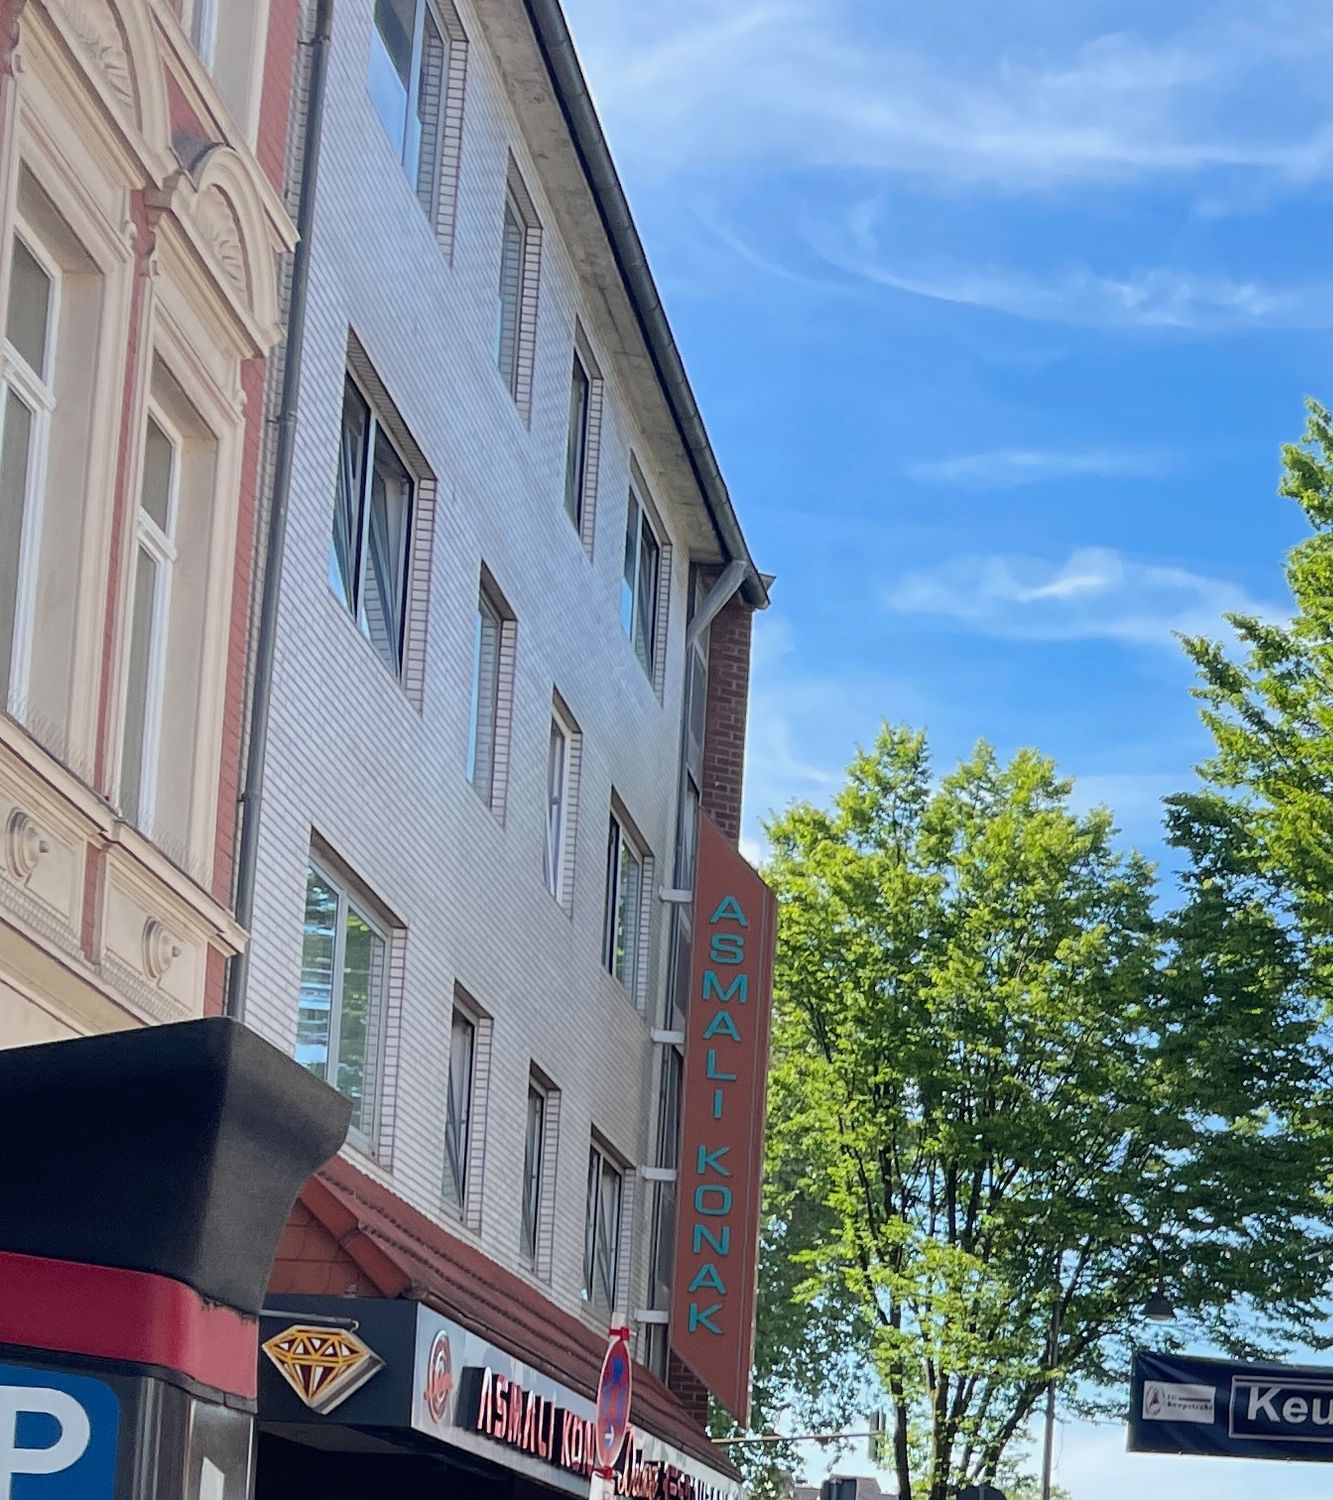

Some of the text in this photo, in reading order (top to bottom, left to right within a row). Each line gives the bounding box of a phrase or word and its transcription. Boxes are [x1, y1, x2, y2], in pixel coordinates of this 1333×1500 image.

[688, 895, 749, 1335] ASMALI KONAK
[561, 1407, 596, 1477] KON
